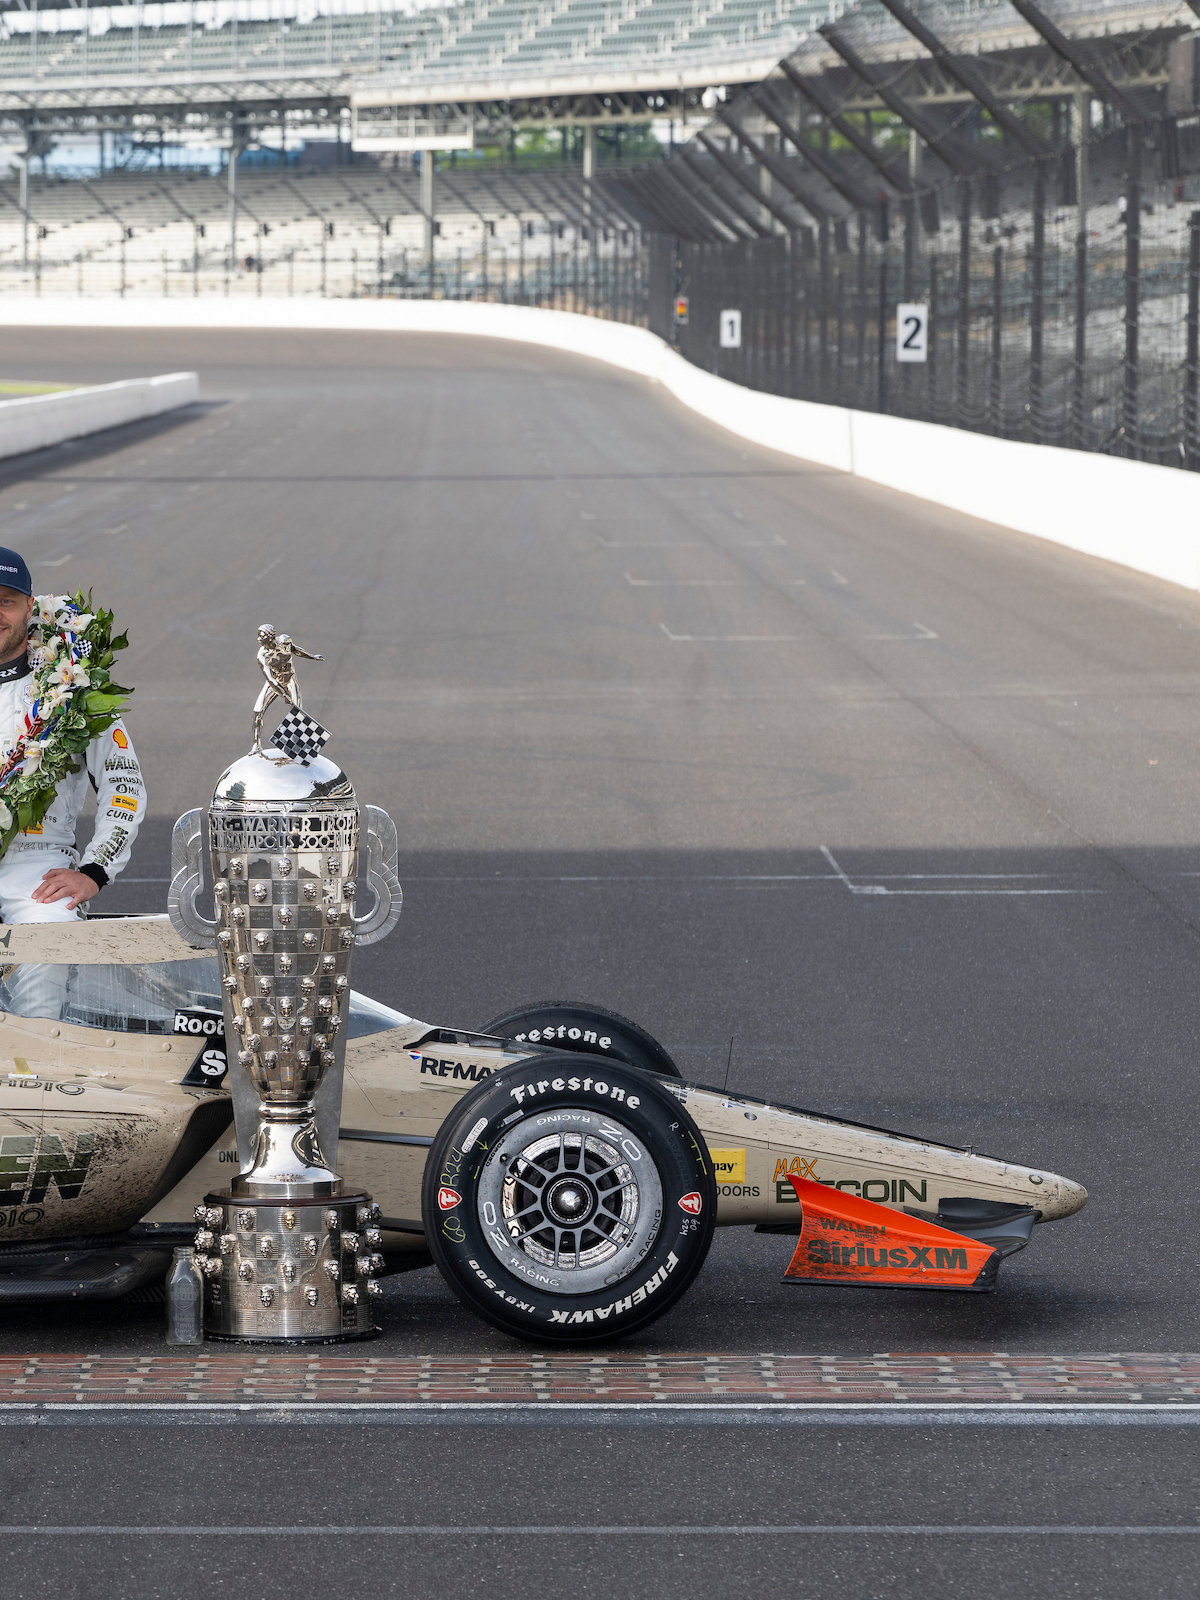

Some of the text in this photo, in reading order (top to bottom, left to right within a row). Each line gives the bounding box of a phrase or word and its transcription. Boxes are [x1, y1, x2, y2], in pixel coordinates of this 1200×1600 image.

[728, 320, 735, 338] 1
[903, 317, 921, 349] 2
[106, 809, 134, 822] CURB
[510, 1076, 641, 1109] Firestone
[773, 1156, 820, 1182] MAX
[776, 1180, 927, 1203] BCOIN
[819, 1217, 886, 1236] WALLEN
[808, 1240, 968, 1270] SiriusXM
[511, 1257, 560, 1287] RACING
[547, 1250, 680, 1324] FIREHAWK
